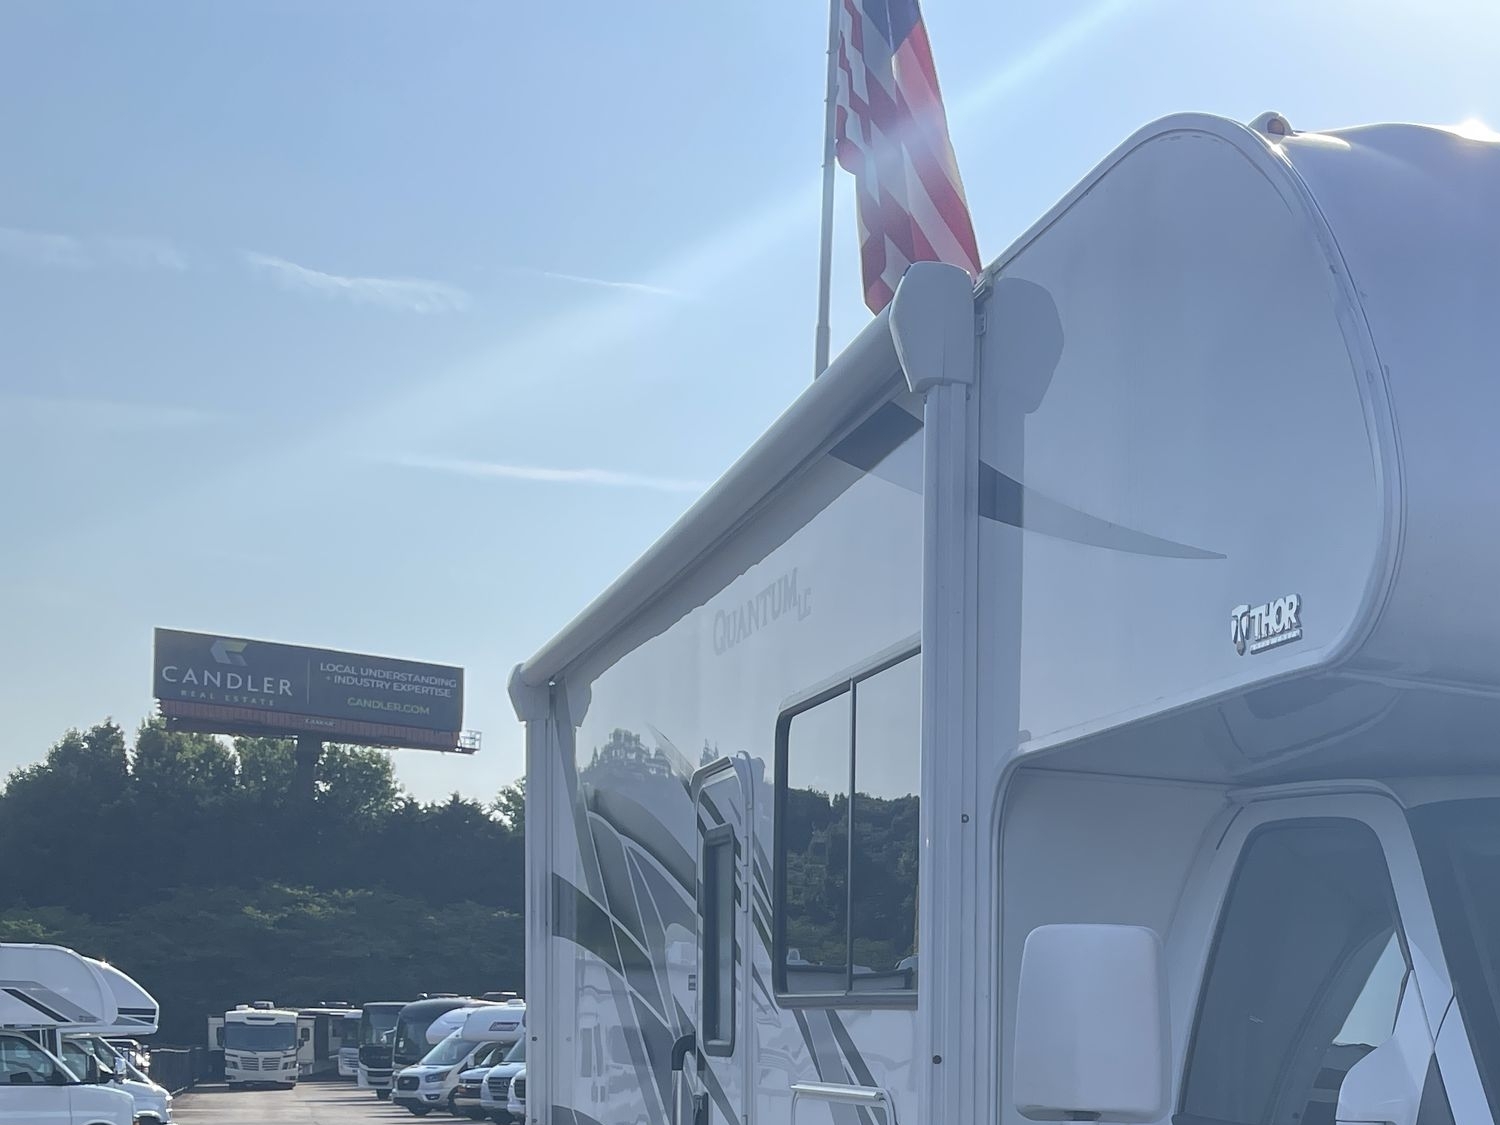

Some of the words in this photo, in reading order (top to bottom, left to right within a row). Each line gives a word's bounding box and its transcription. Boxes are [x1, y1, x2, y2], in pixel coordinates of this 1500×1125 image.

[713, 567, 798, 657] QUANTUM
[797, 586, 812, 622] LC
[1250, 594, 1299, 641] THOR
[161, 665, 294, 697] CANDLER
[320, 662, 358, 676] LOCAL
[360, 667, 457, 689] UNDERSTANDING
[334, 675, 391, 690] INDUSTRY
[392, 682, 452, 698] EXPERTISE
[180, 689, 214, 699] REAL
[224, 695, 275, 706] ESTATE
[347, 697, 431, 715] CANDLER.COM
